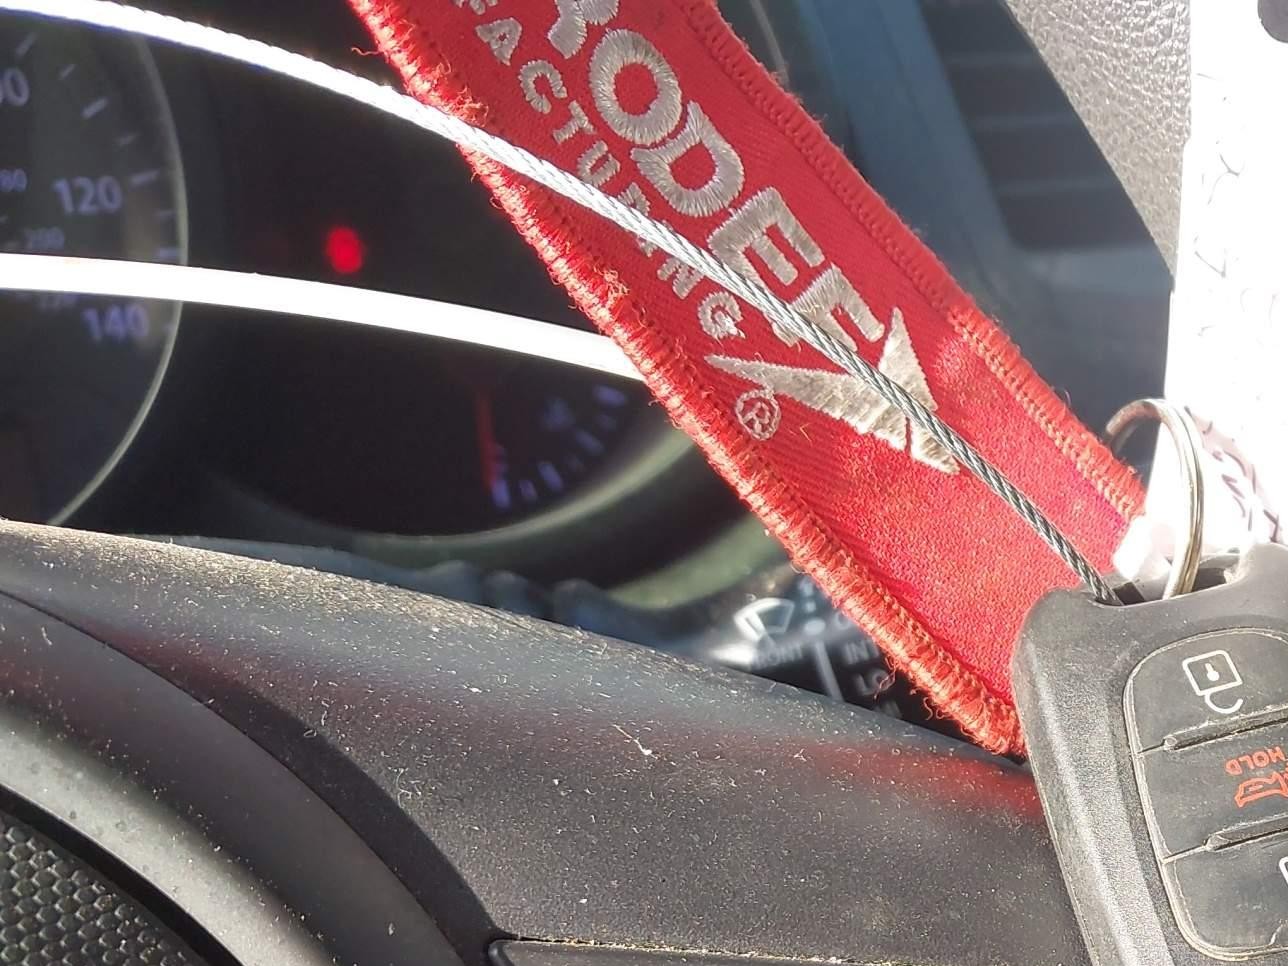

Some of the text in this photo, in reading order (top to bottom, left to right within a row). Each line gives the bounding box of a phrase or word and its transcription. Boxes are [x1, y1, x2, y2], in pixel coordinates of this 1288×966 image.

[54, 175, 123, 214] 120
[82, 302, 149, 340] 140
[1224, 745, 1286, 776] HOLD
